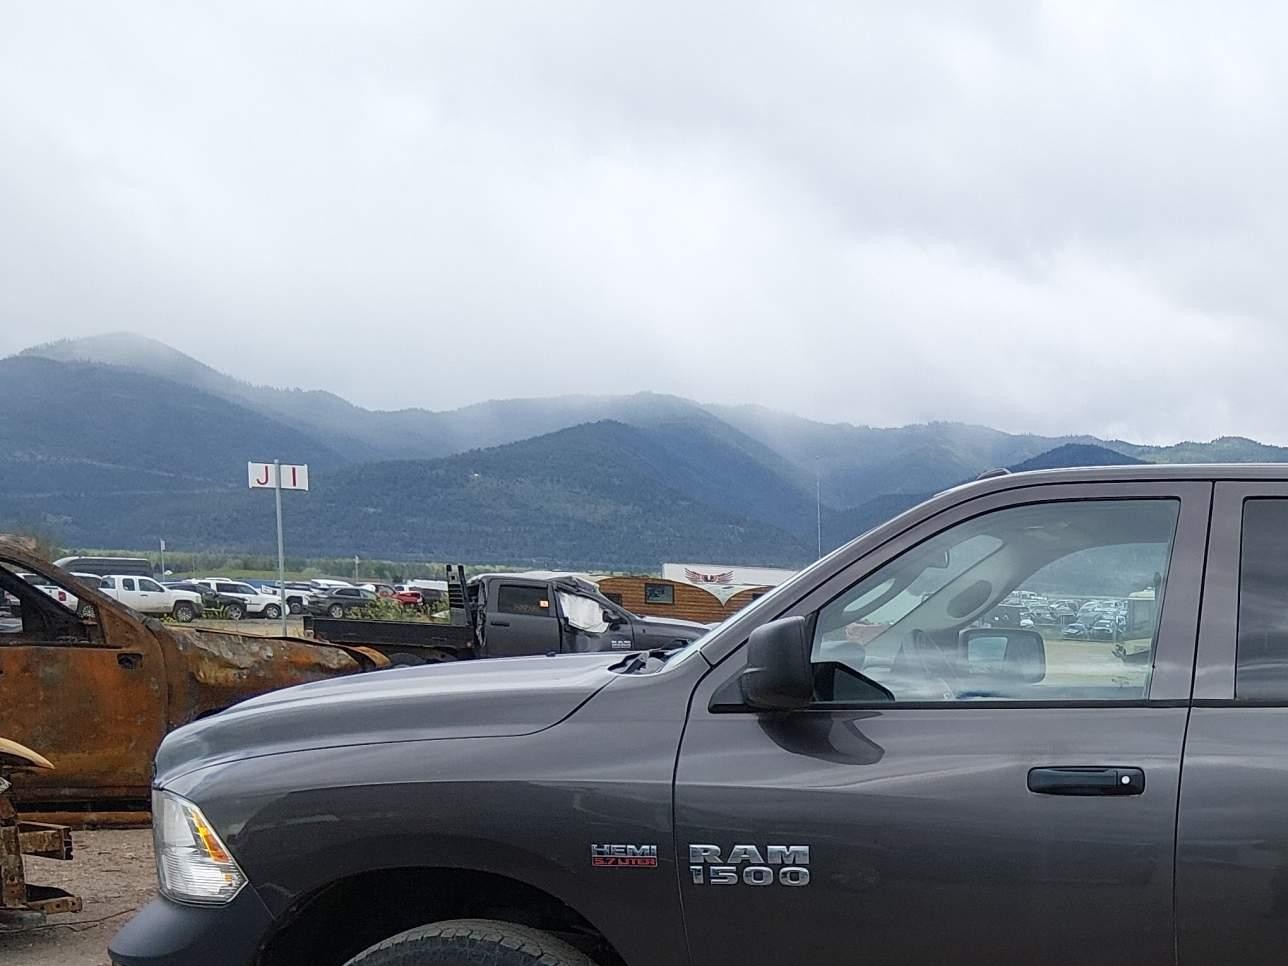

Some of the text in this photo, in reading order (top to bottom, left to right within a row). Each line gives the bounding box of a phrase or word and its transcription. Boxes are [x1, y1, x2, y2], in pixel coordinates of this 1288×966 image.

[256, 465, 269, 485] J
[592, 844, 657, 856] HEMI
[689, 844, 810, 864] RAM
[617, 857, 656, 865] LITER
[690, 866, 810, 887] 1500
